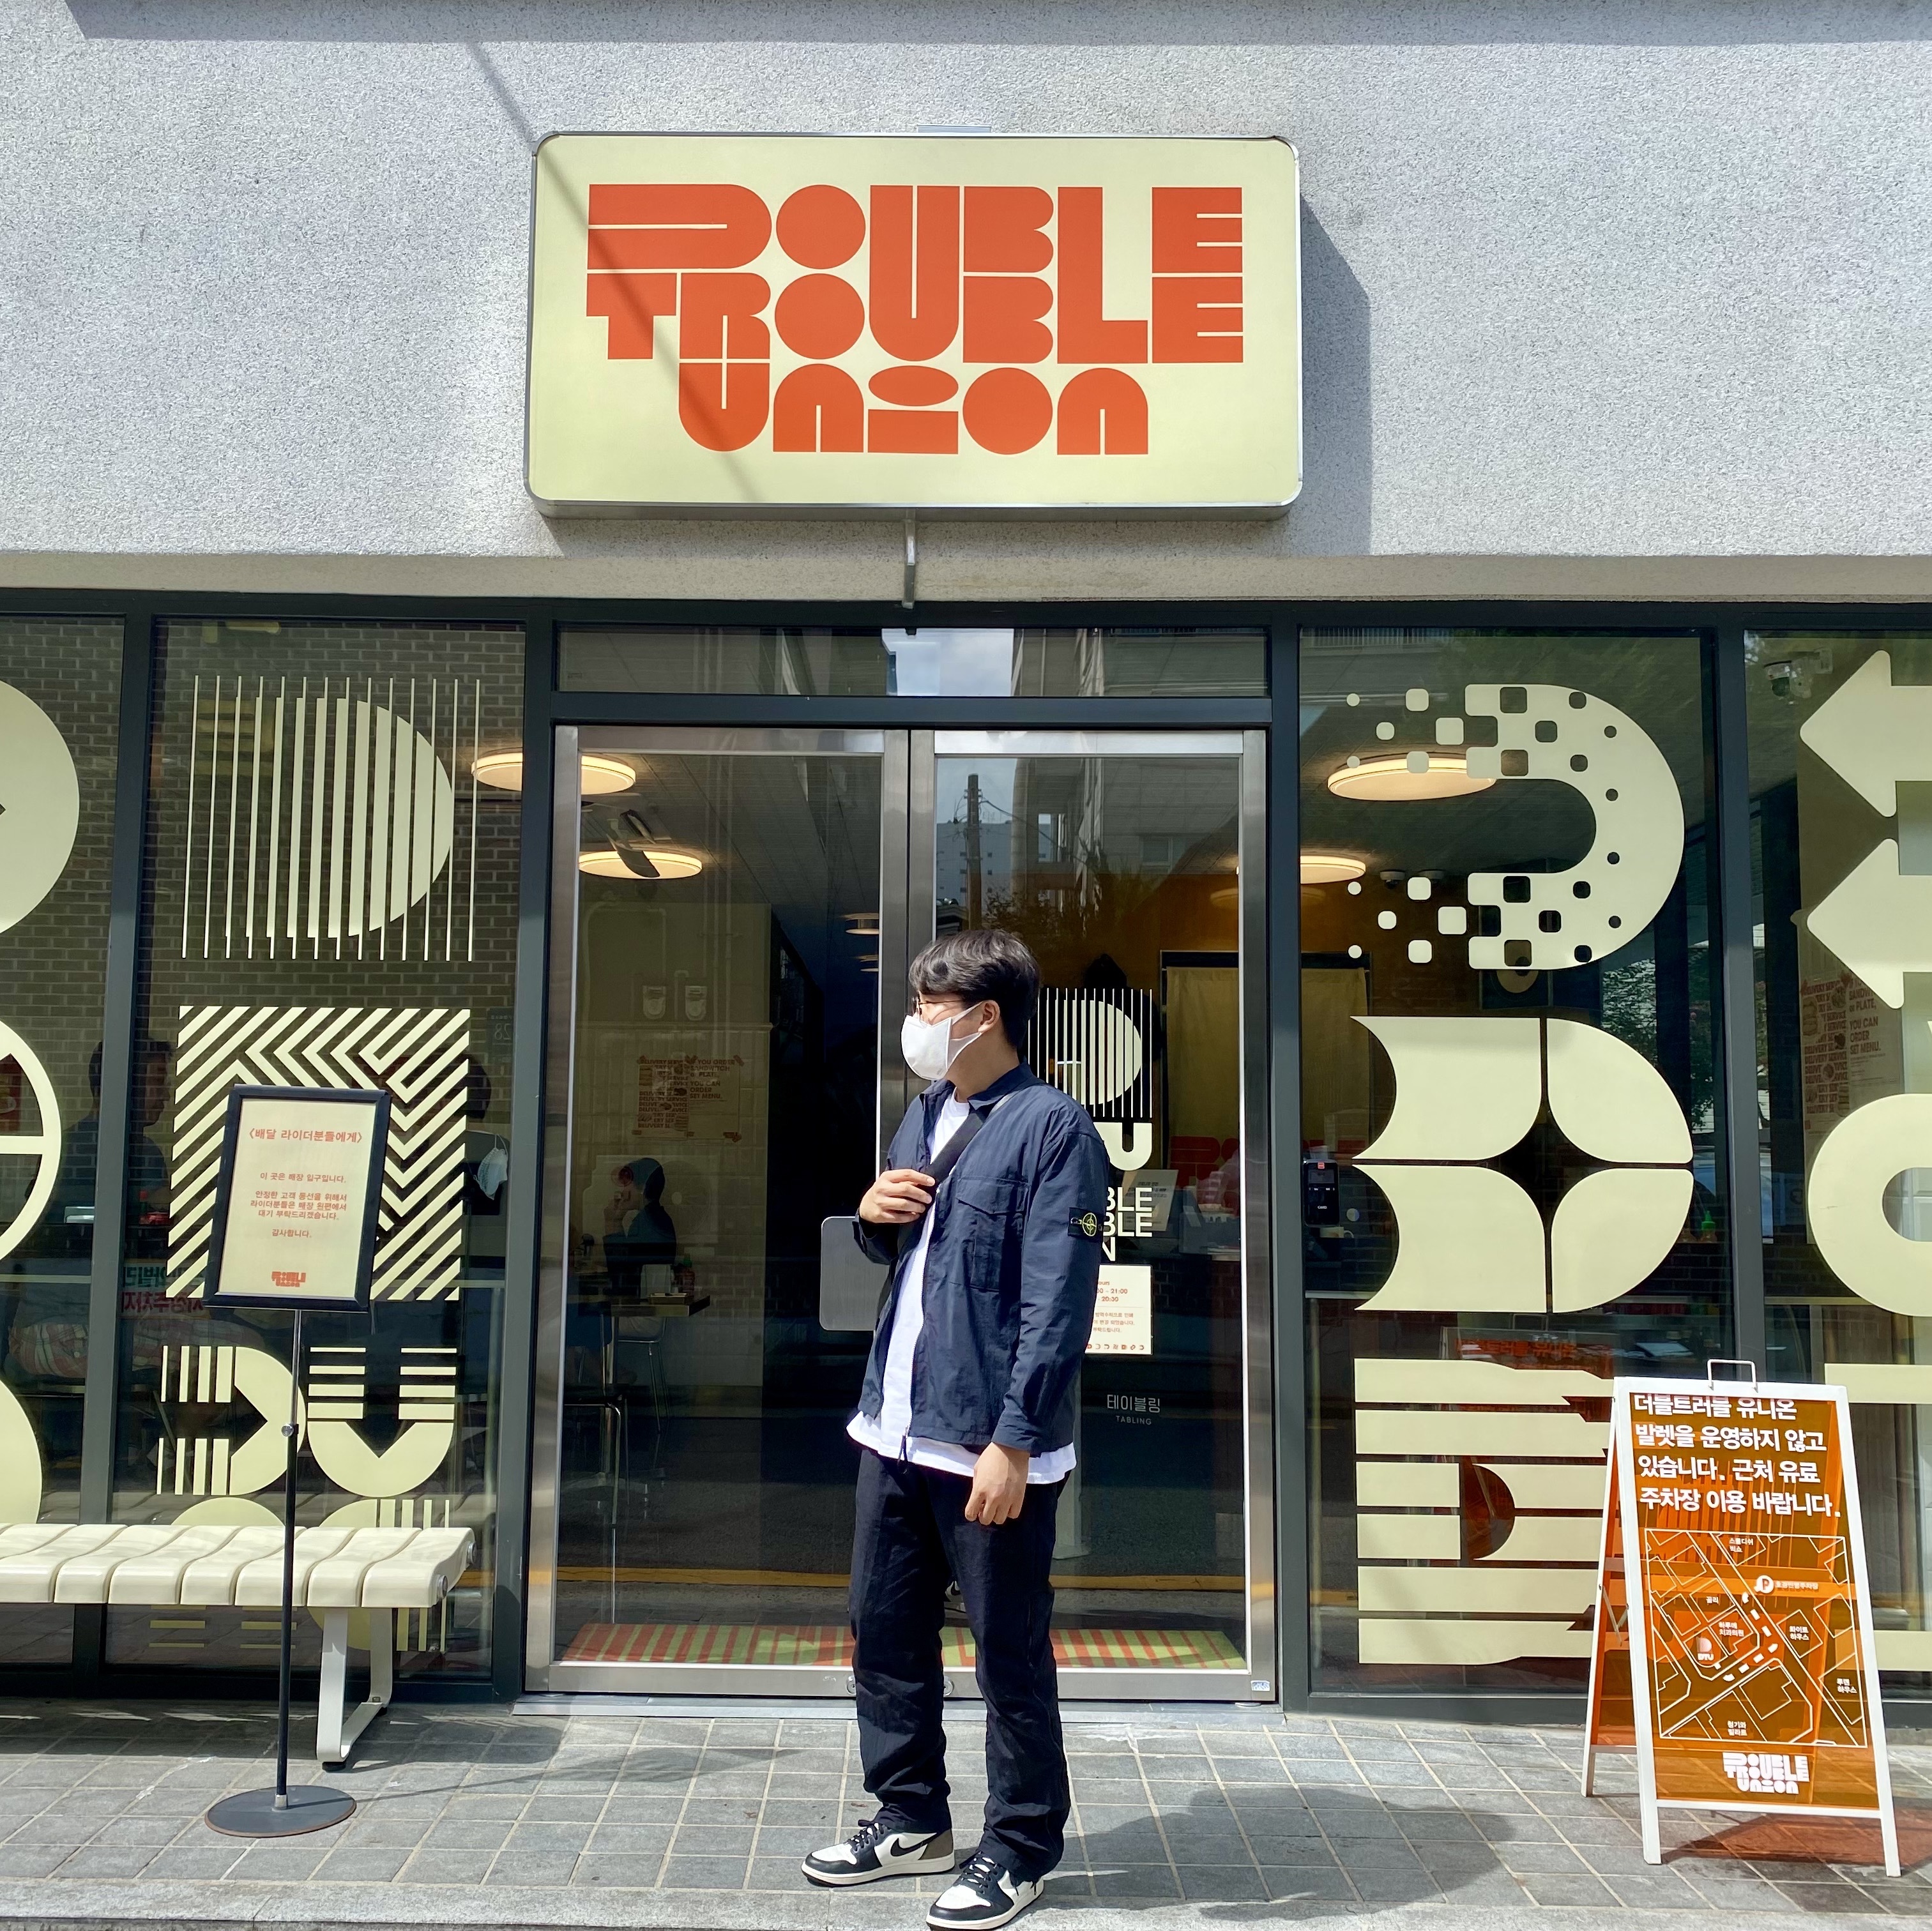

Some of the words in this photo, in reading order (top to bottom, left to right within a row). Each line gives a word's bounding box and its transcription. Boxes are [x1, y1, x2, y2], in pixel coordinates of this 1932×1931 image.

[588, 184, 1244, 273] DOUBLE
[1849, 1019, 1862, 1031] YOU
[1863, 1016, 1879, 1028] CAN
[1850, 1030, 1870, 1043] ORDER
[1850, 1044, 1859, 1054] SET
[270, 1172, 285, 1181] 곳은
[288, 1173, 304, 1181] 매장
[280, 1192, 296, 1200] 고객
[250, 1200, 296, 1209] 라이더분들은
[298, 1201, 314, 1210] 매장
[258, 1209, 273, 1218] 대기
[271, 1229, 312, 1238] 감사합니다.
[1107, 1394, 1160, 1413] 테이블링
[1634, 1393, 1732, 1418] 더블트러블
[1737, 1397, 1798, 1420] 유니온
[1115, 1415, 1152, 1425] TABLING
[1635, 1423, 1695, 1448] 발렛을
[1700, 1425, 1780, 1451] 운영하지
[1784, 1429, 1827, 1453] 않고
[1638, 1455, 1726, 1481] 있습니다.
[1732, 1458, 1775, 1483] 근처
[1778, 1460, 1821, 1484] 유료
[1640, 1487, 1701, 1511] 주차장
[1707, 1489, 1747, 1513] 이용
[1752, 1491, 1841, 1518] 바랍니다.
